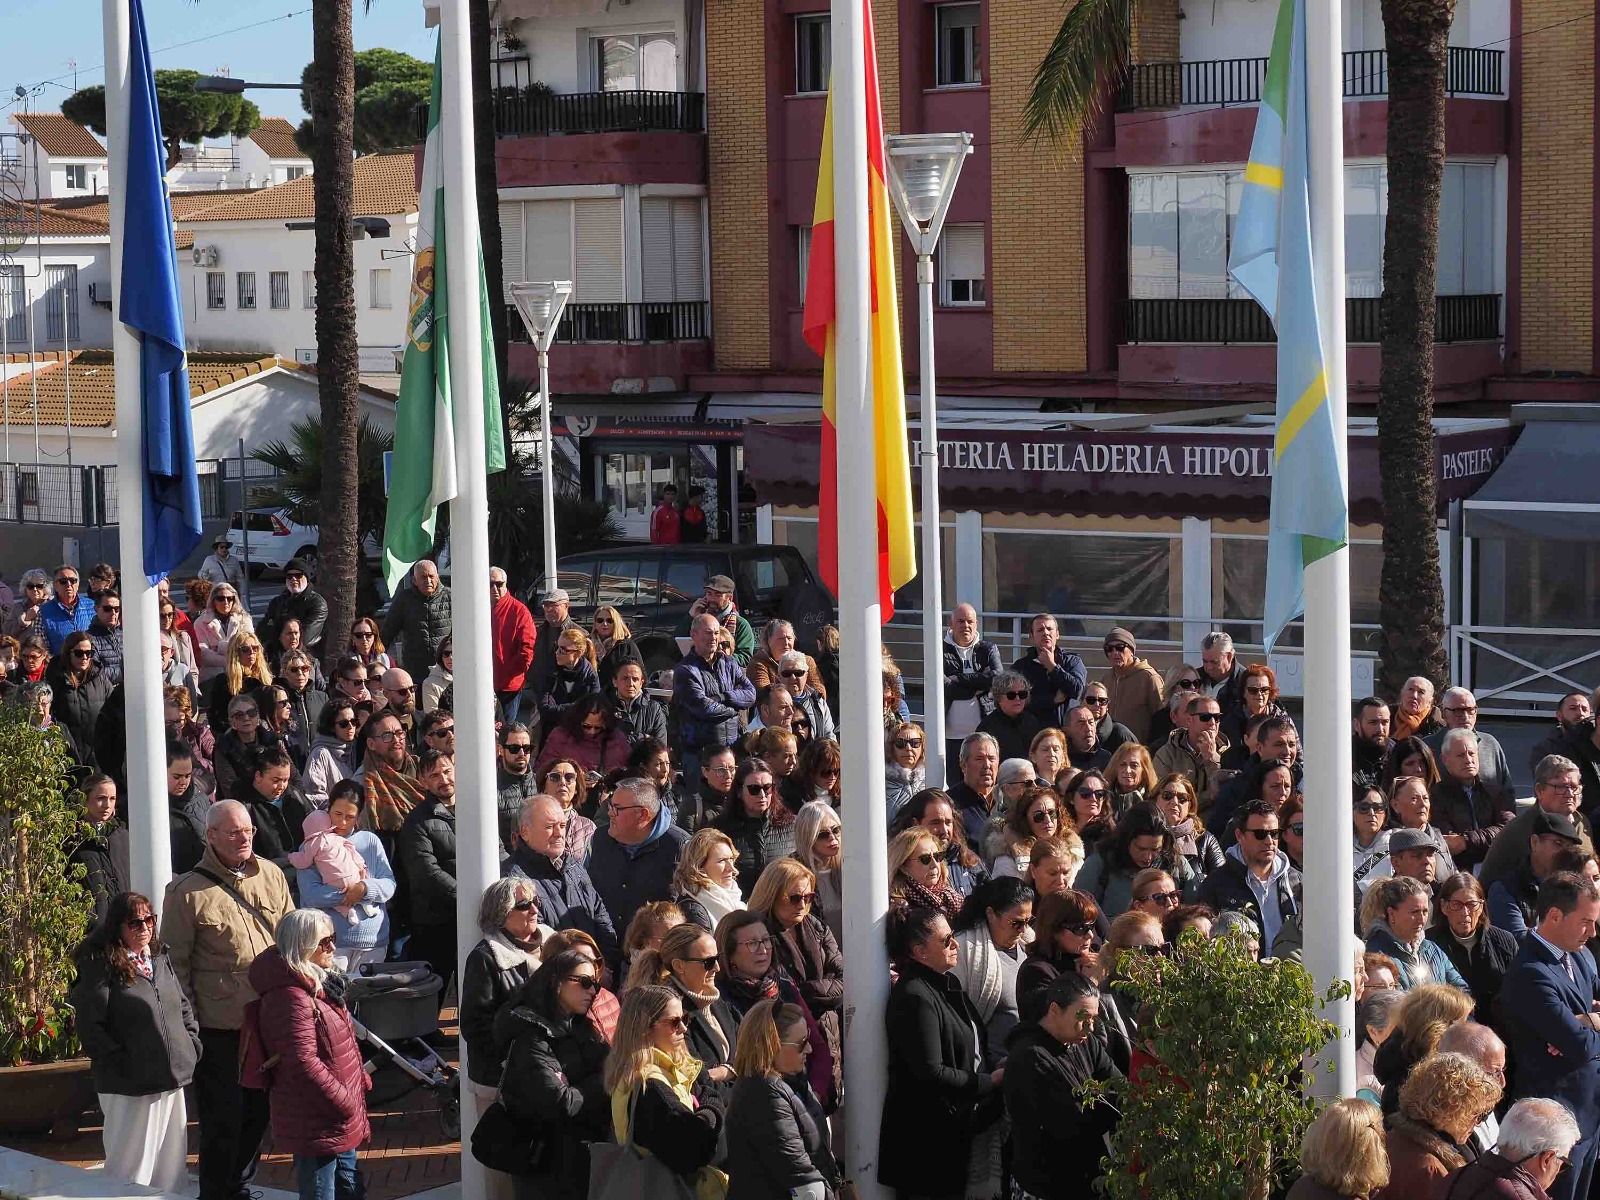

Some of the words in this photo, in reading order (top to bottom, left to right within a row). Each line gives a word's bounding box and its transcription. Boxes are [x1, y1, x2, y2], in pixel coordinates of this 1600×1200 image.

[1021, 443, 1174, 474] HELADERIA
[1182, 446, 1274, 477] HIPOLI
[1442, 447, 1493, 480] PASTELES
